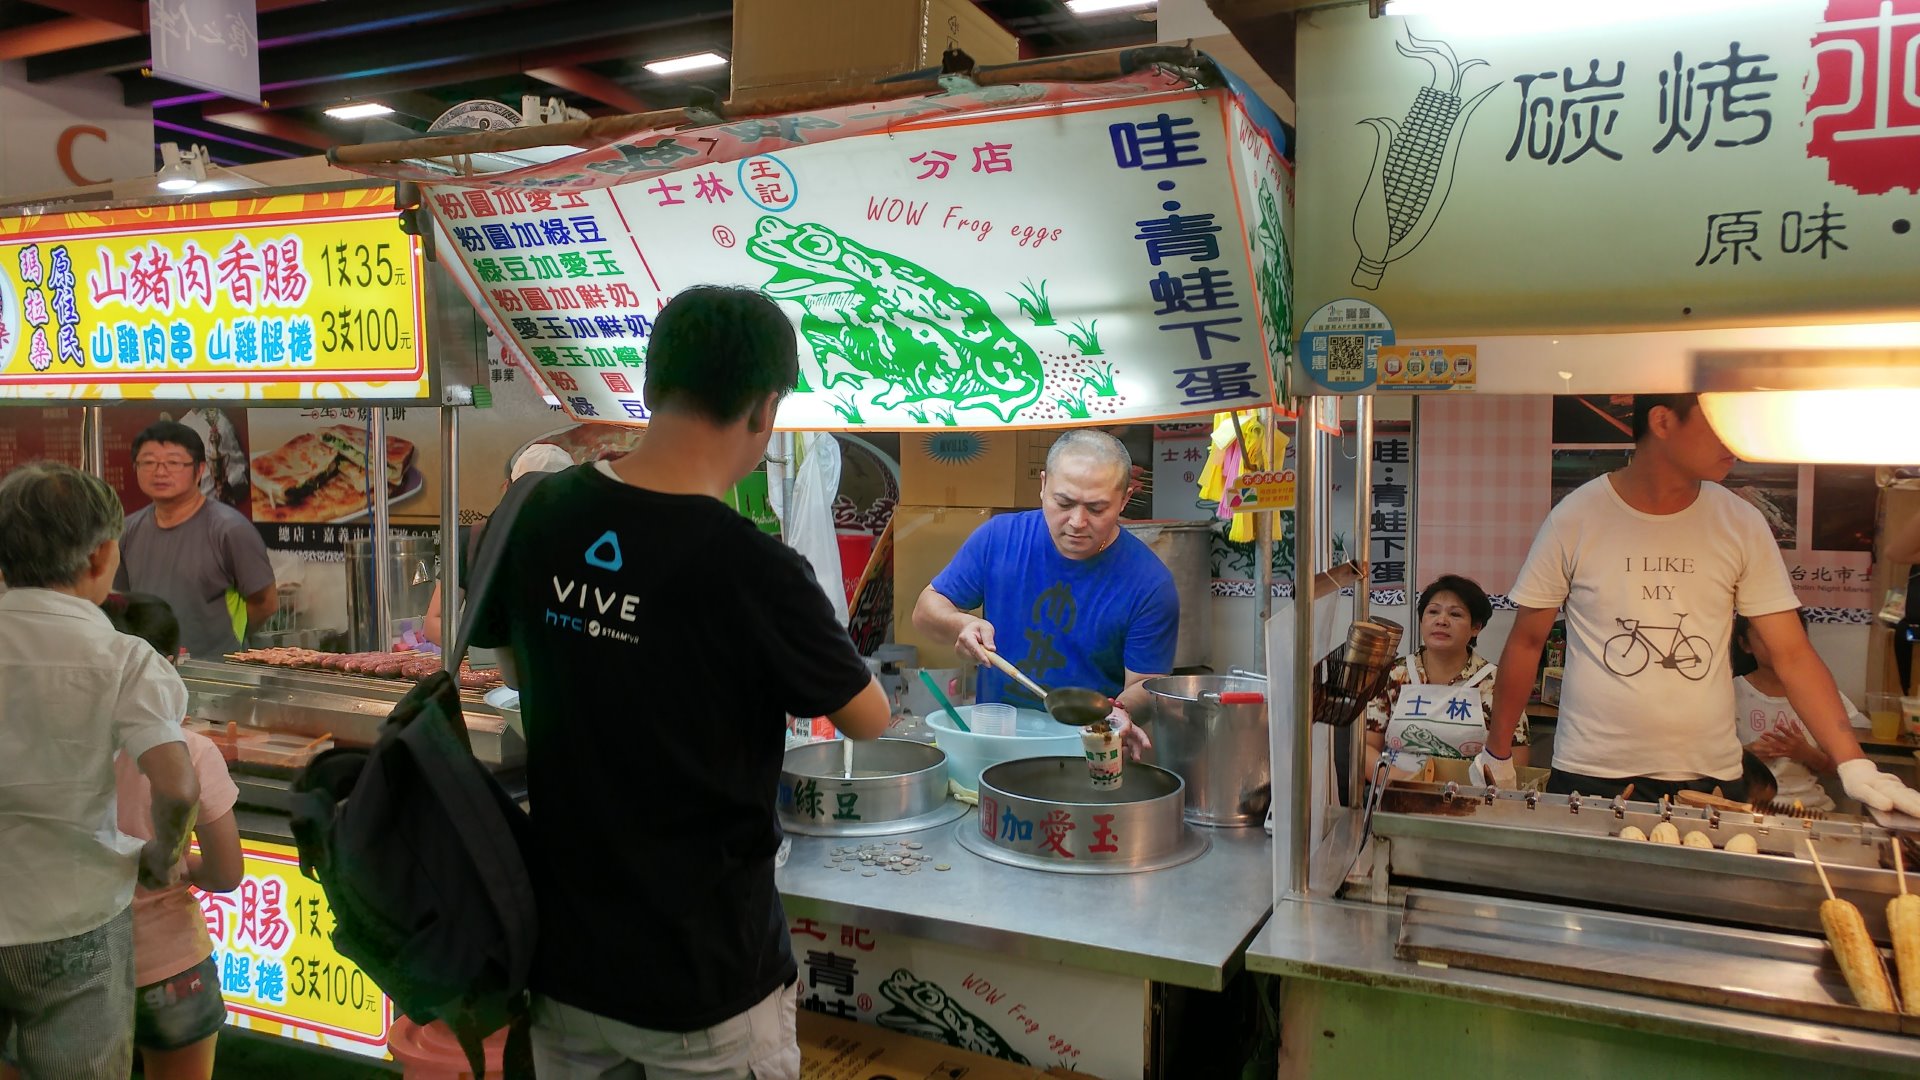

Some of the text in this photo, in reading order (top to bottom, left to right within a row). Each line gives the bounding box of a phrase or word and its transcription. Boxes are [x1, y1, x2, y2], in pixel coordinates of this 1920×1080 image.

[1505, 41, 1778, 165] 碳烤
[648, 141, 1014, 207] 士林 王記 分店
[434, 187, 590, 220] 粉圓加愛玉
[867, 196, 1063, 248] WOW Frog eggs
[453, 215, 607, 252] 粉圓加綠豆
[1695, 202, 1849, 267] 原味
[92, 238, 407, 308] 山豬肉香腸 1支35元
[473, 250, 625, 283] 綠豆加愛玉
[19, 244, 53, 371] 瑪拉桑
[48, 247, 85, 367] 原住民
[490, 283, 640, 312] 粉圓加鮮奶
[92, 306, 412, 364] 山雞肉串 山雞腿捲 3支100元
[511, 314, 652, 340] 愛玉加鮮奶
[531, 346, 649, 368] 愛玉加檸
[1161, 447, 1203, 462] 士林
[1625, 556, 1695, 574] I LIKE
[553, 575, 641, 622] VIVE
[1641, 584, 1676, 601] MY
[545, 608, 583, 632] htc
[1405, 695, 1473, 720] 士林
[1750, 709, 1804, 732] GA
[981, 794, 1119, 859] 圓加愛玉
[211, 952, 377, 1013] 腿捲 3支100元
[961, 972, 1082, 1059] WOW Frog eggs
